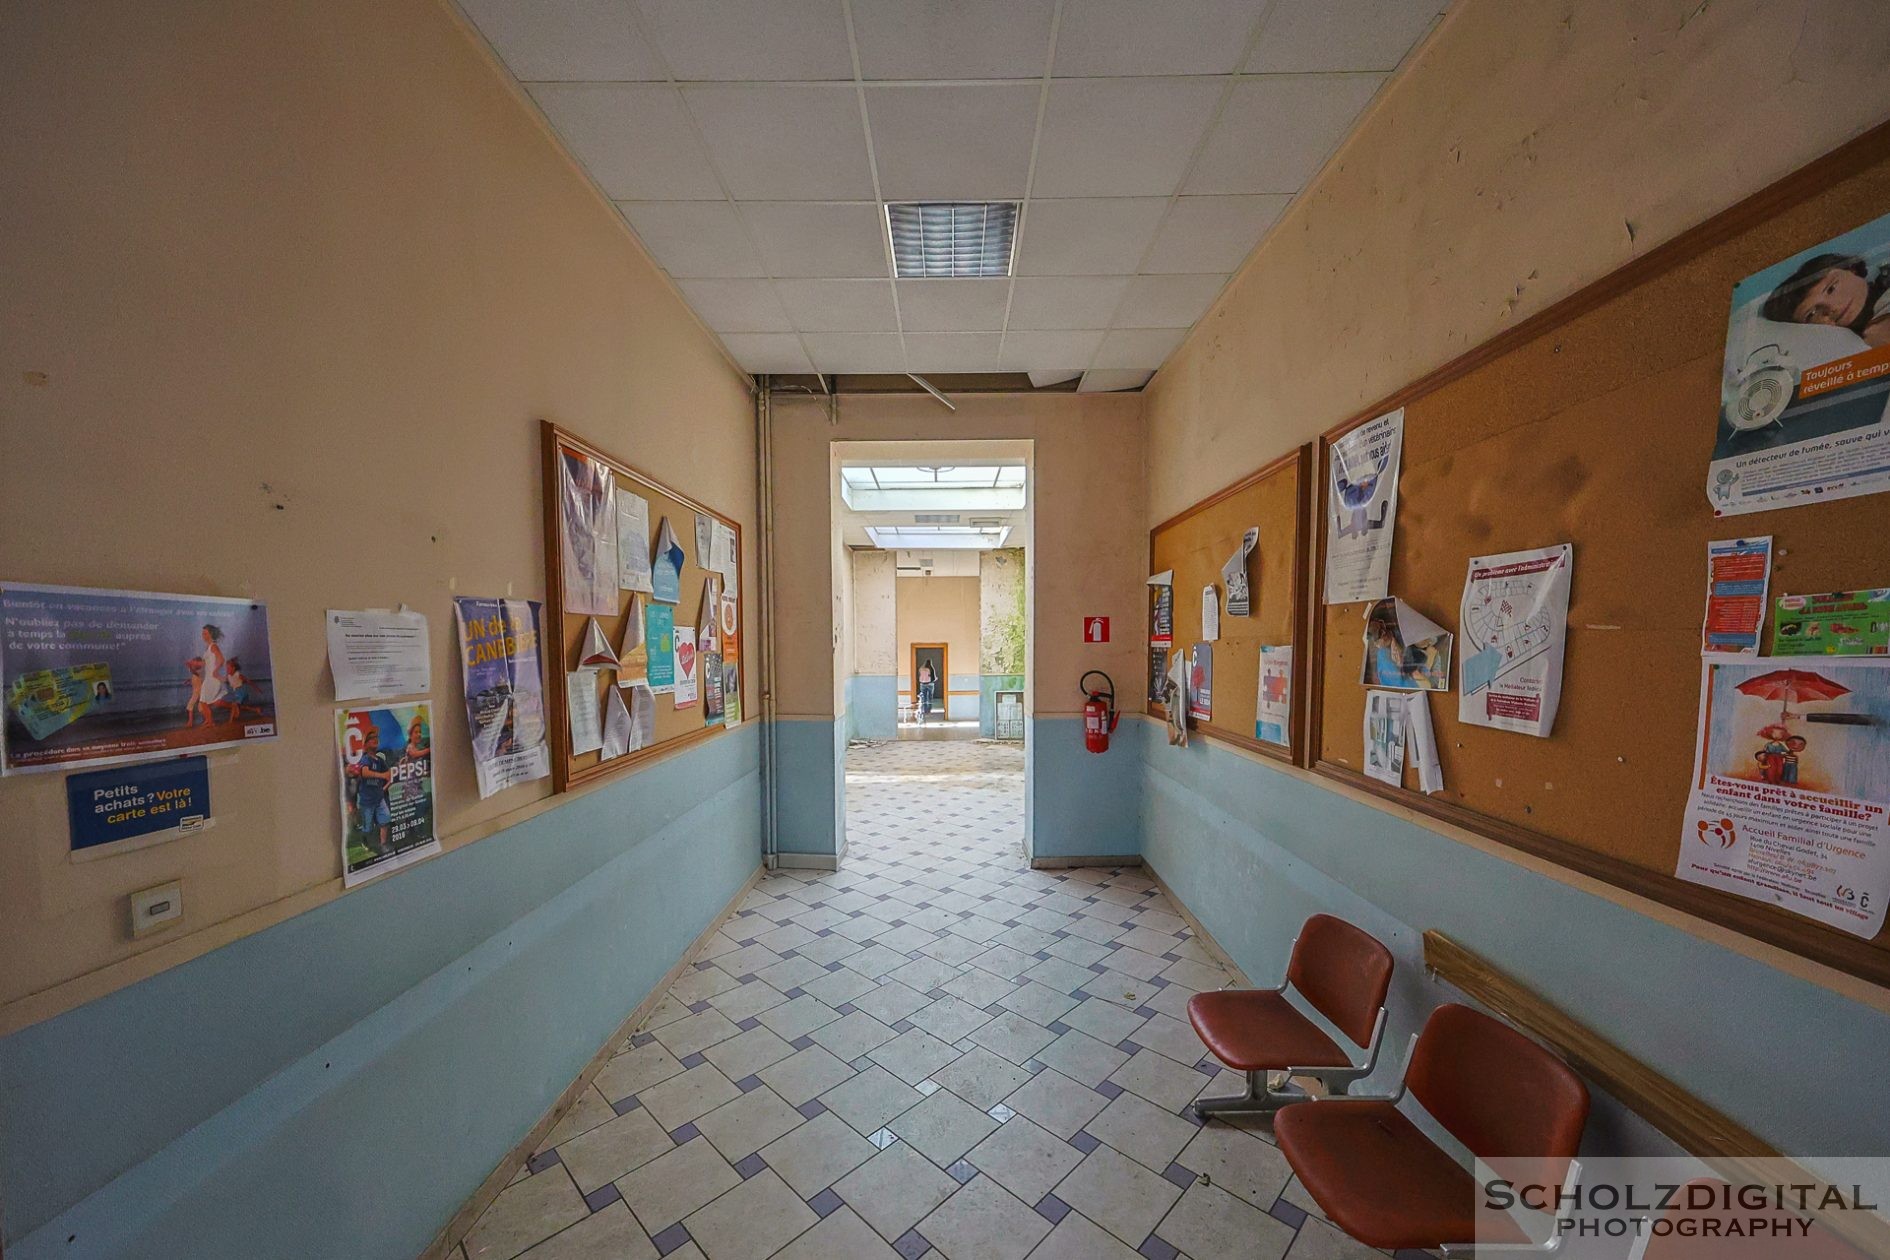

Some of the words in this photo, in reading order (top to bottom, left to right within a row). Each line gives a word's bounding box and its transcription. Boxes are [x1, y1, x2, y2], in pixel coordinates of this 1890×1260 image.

[1803, 374, 1844, 393] réveillé
[1846, 371, 1854, 381] à
[1856, 363, 1890, 378] temp
[1806, 361, 1853, 381] Toujours
[1366, 422, 1382, 433] revenu
[1384, 417, 1390, 426] et
[1736, 461, 1747, 469] Un
[1748, 452, 1787, 466] détecteur
[1788, 448, 1799, 457] de
[1801, 441, 1832, 455] fumée,
[1834, 436, 1863, 447] sauve
[1865, 430, 1881, 441] qui
[5, 617, 59, 627] N'oubliez
[63, 620, 84, 630] pas
[88, 620, 104, 629] de
[106, 621, 160, 631] demander
[18, 630, 54, 641] temps
[56, 629, 66, 638] la
[463, 617, 486, 642] UN
[488, 614, 506, 637] de
[9, 641, 24, 650] de
[27, 641, 56, 650] votre
[390, 760, 427, 783] PEPS!
[93, 785, 138, 801] Petits
[95, 796, 145, 814] achats
[156, 787, 191, 801] Votre
[1710, 775, 1759, 792] Êtes-vous
[1762, 787, 1787, 797] prêt
[1790, 790, 1796, 798] à
[1799, 793, 1861, 810] accueillir
[1864, 804, 1883, 814] un
[1716, 788, 1751, 799] enfant
[1754, 793, 1781, 804] dans
[1784, 799, 1816, 811] votre
[1819, 804, 1872, 821] famille?
[107, 808, 146, 824] carte
[150, 803, 171, 815] est
[175, 799, 187, 809] là
[1760, 802, 1783, 812] familles
[1811, 813, 1841, 823] participer
[1858, 823, 1879, 831] projet
[1762, 810, 1782, 819] enfant
[1791, 816, 1818, 826] urgence
[1820, 821, 1841, 831] sociale
[1842, 827, 1858, 835] pour
[1742, 825, 1775, 838] Accueil
[1777, 832, 1814, 847] Familial
[1816, 841, 1867, 860] d'Urgence
[1748, 815, 1779, 826] maximum
[1822, 831, 1839, 839] toute
[1853, 837, 1876, 846] famille
[1766, 845, 1791, 856] Nivelles
[1773, 840, 1794, 851] Cheval
[1691, 863, 1709, 872] Pour
[1733, 874, 1754, 884] enfant
[1799, 893, 1815, 903] faut
[1816, 898, 1833, 908] tout
[1845, 908, 1869, 921] village
